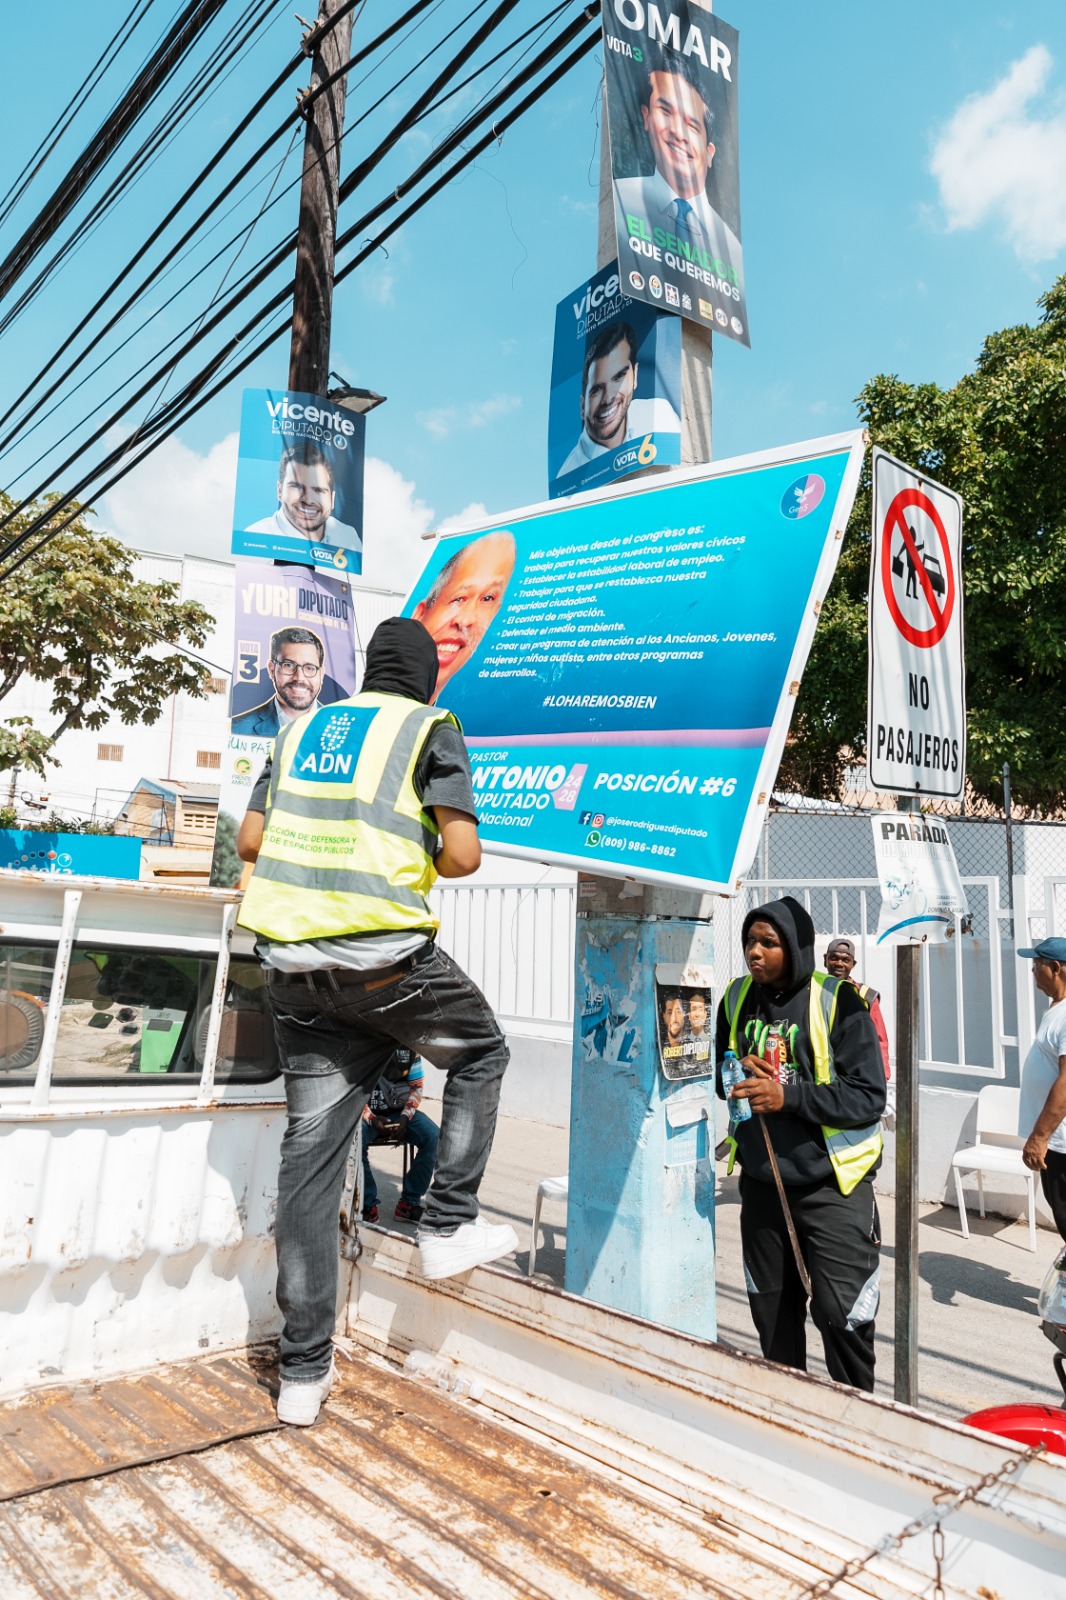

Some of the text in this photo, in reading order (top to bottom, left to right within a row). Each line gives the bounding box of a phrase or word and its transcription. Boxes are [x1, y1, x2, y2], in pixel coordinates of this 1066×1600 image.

[614, 0, 732, 83] OMAR
[627, 213, 739, 288] EL SENADOR
[629, 236, 740, 301] QUE QUEREMOS
[573, 274, 619, 319] vice
[266, 397, 355, 436] vicente
[272, 420, 332, 441] DIPUTADO
[616, 434, 657, 467] VOTA 6
[524, 535, 746, 572] trabaja para recuperar nuestros valores cívicos
[529, 525, 705, 560] Mis objetivos desde el congreso es:
[313, 550, 333, 561] VOTA
[333, 548, 348, 569] 6
[523, 554, 725, 585] Establecer la estabilidad laboral de empleo.
[519, 571, 707, 598] Trabajar para que se restablezca nuestra
[241, 583, 348, 621] YURI DIPUTADO
[507, 594, 598, 613] seguridad ciudadana.
[507, 607, 606, 624] El control de migración.
[501, 621, 626, 637] Defender el medio ambiente.
[240, 642, 258, 654] VOTA
[495, 632, 777, 652] Crear un programa de atención al los Ancianos, Jovenes,
[240, 654, 258, 680] 3
[484, 651, 704, 666] mujeres y niños autista, entre otros programas
[478, 668, 537, 678] de desarrollos.
[543, 695, 657, 709] #LOHAREMOSBIEN
[909, 672, 929, 710] NO
[251, 741, 272, 755] PAÍ
[470, 751, 508, 762] PASTOR
[877, 724, 958, 773] PASAJEROS
[300, 753, 352, 774] ADN
[472, 765, 566, 790] NTONIO
[564, 775, 582, 788] 24
[593, 770, 737, 797] POSICIÓN #6
[558, 790, 576, 802] 28
[479, 812, 534, 827] Nacional
[606, 816, 708, 838] @joserodriguezdiputado
[270, 835, 281, 845] DE
[283, 839, 322, 853] ESPACIOS
[298, 832, 309, 841] DE
[881, 822, 949, 846] PARADA
[601, 834, 676, 857] (809) 986-8862
